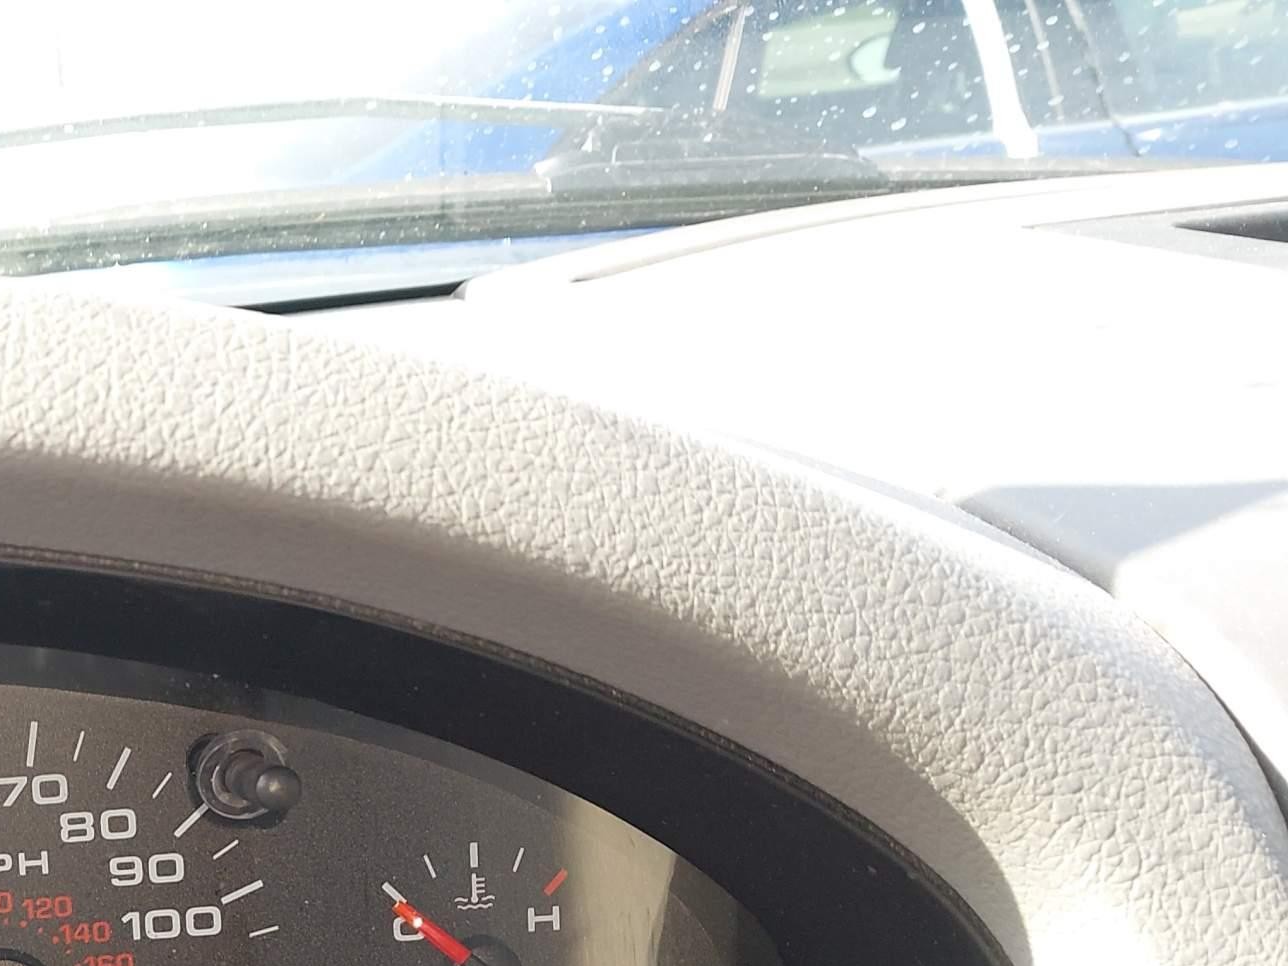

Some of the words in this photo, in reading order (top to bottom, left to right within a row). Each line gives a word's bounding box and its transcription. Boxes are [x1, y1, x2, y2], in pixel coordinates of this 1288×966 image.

[60, 808, 137, 842] 80
[109, 853, 185, 886] 90
[21, 896, 73, 918] 120
[527, 905, 561, 932] H
[60, 921, 111, 943] 140
[122, 906, 222, 941] 100
